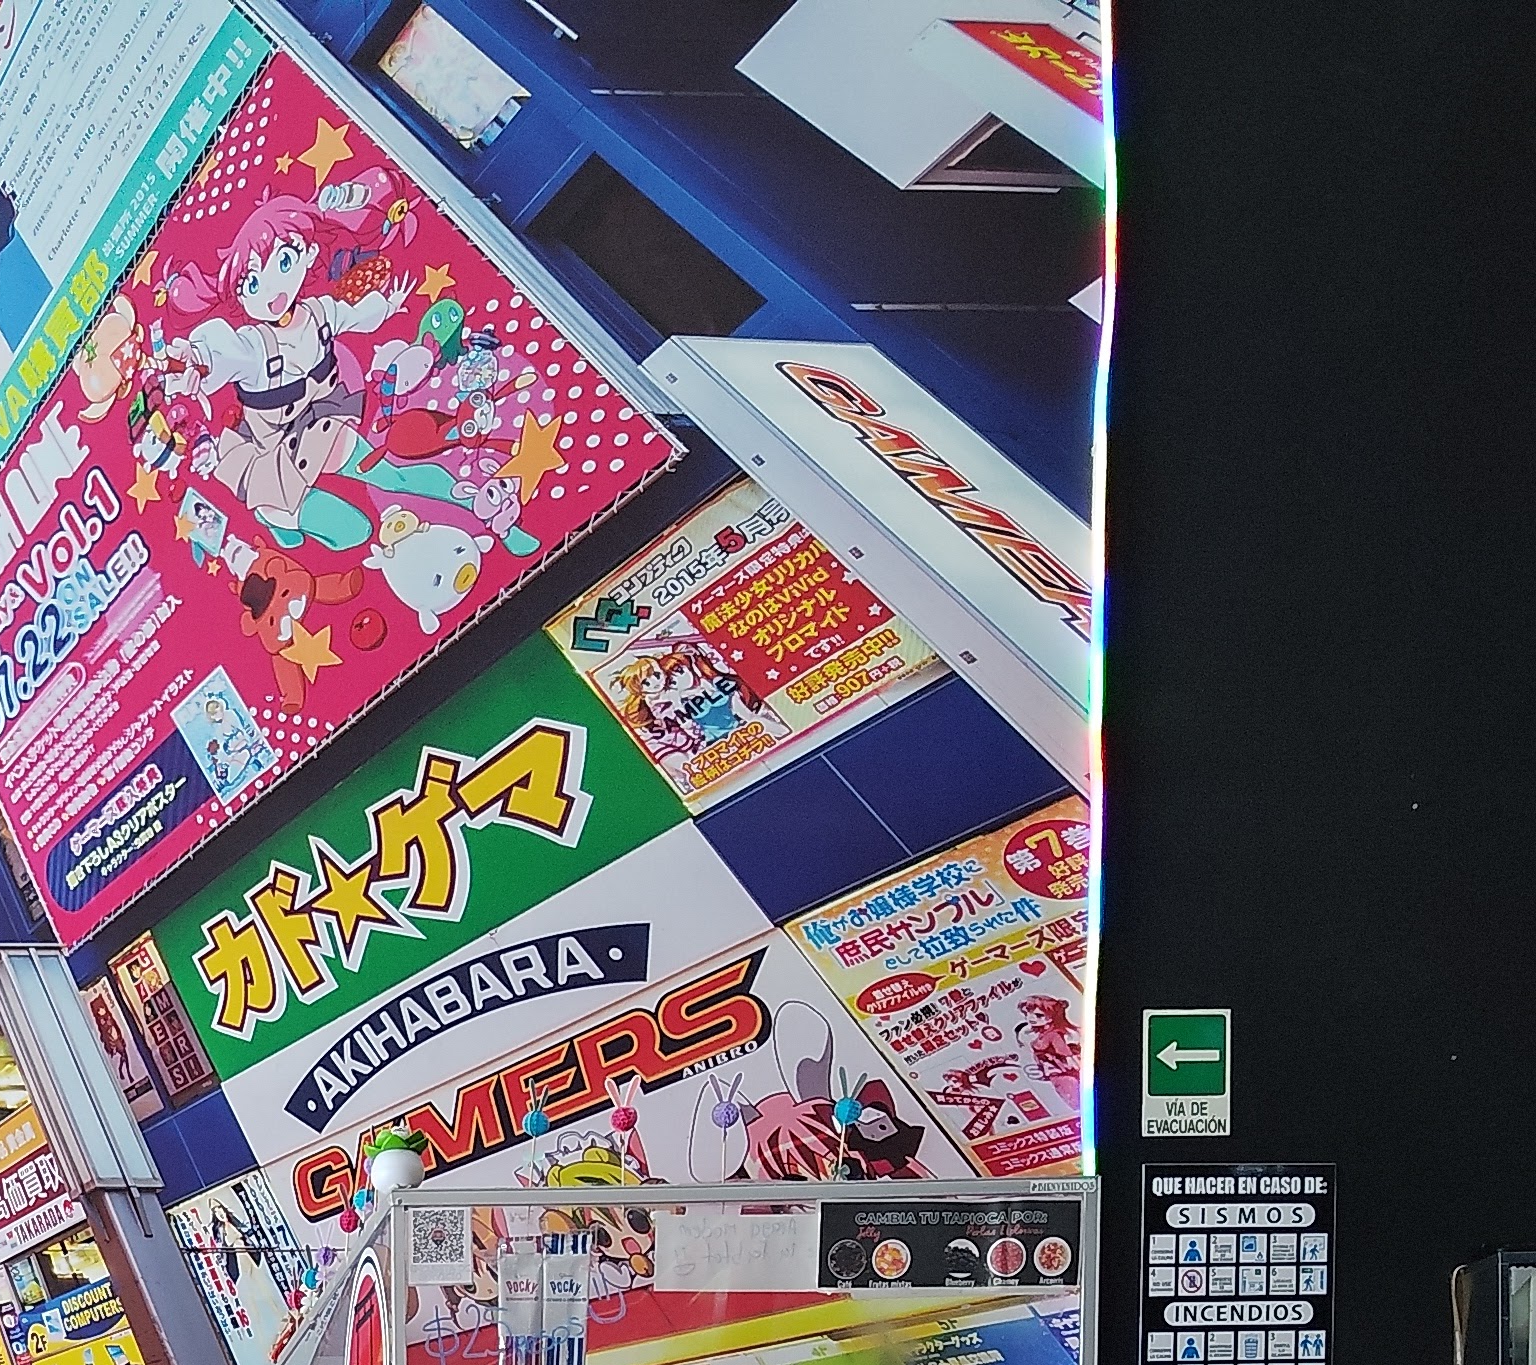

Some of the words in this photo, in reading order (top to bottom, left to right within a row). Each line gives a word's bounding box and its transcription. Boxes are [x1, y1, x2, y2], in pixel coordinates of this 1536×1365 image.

[752, 586, 837, 647] オリジナル
[786, 629, 902, 704] 好評発売中!!
[648, 680, 737, 739] SAMPLE
[314, 935, 604, 1110] AKIHABARA
[682, 1040, 758, 1079] ANIBRO
[1166, 1098, 1187, 1116] VÍA
[1191, 1101, 1208, 1116] DE
[1147, 1115, 1227, 1134] EVACUACIÓN
[1152, 1176, 1183, 1195] QUE
[1185, 1176, 1235, 1195] HACER
[1238, 1176, 1257, 1195] EN
[1260, 1176, 1301, 1195] CASO
[1304, 1176, 1328, 1195] DE:
[13, 1202, 65, 1246] TAKARADA
[854, 1210, 916, 1227] CAMBIA
[918, 1211, 940, 1226] TU
[941, 1210, 1008, 1227] TAPIOCA
[1179, 1206, 1305, 1225] SISMOS
[61, 1282, 113, 1314] DISCOUNT
[1175, 1304, 1304, 1322] INCENDIOS
[31, 1332, 48, 1354] 2F
